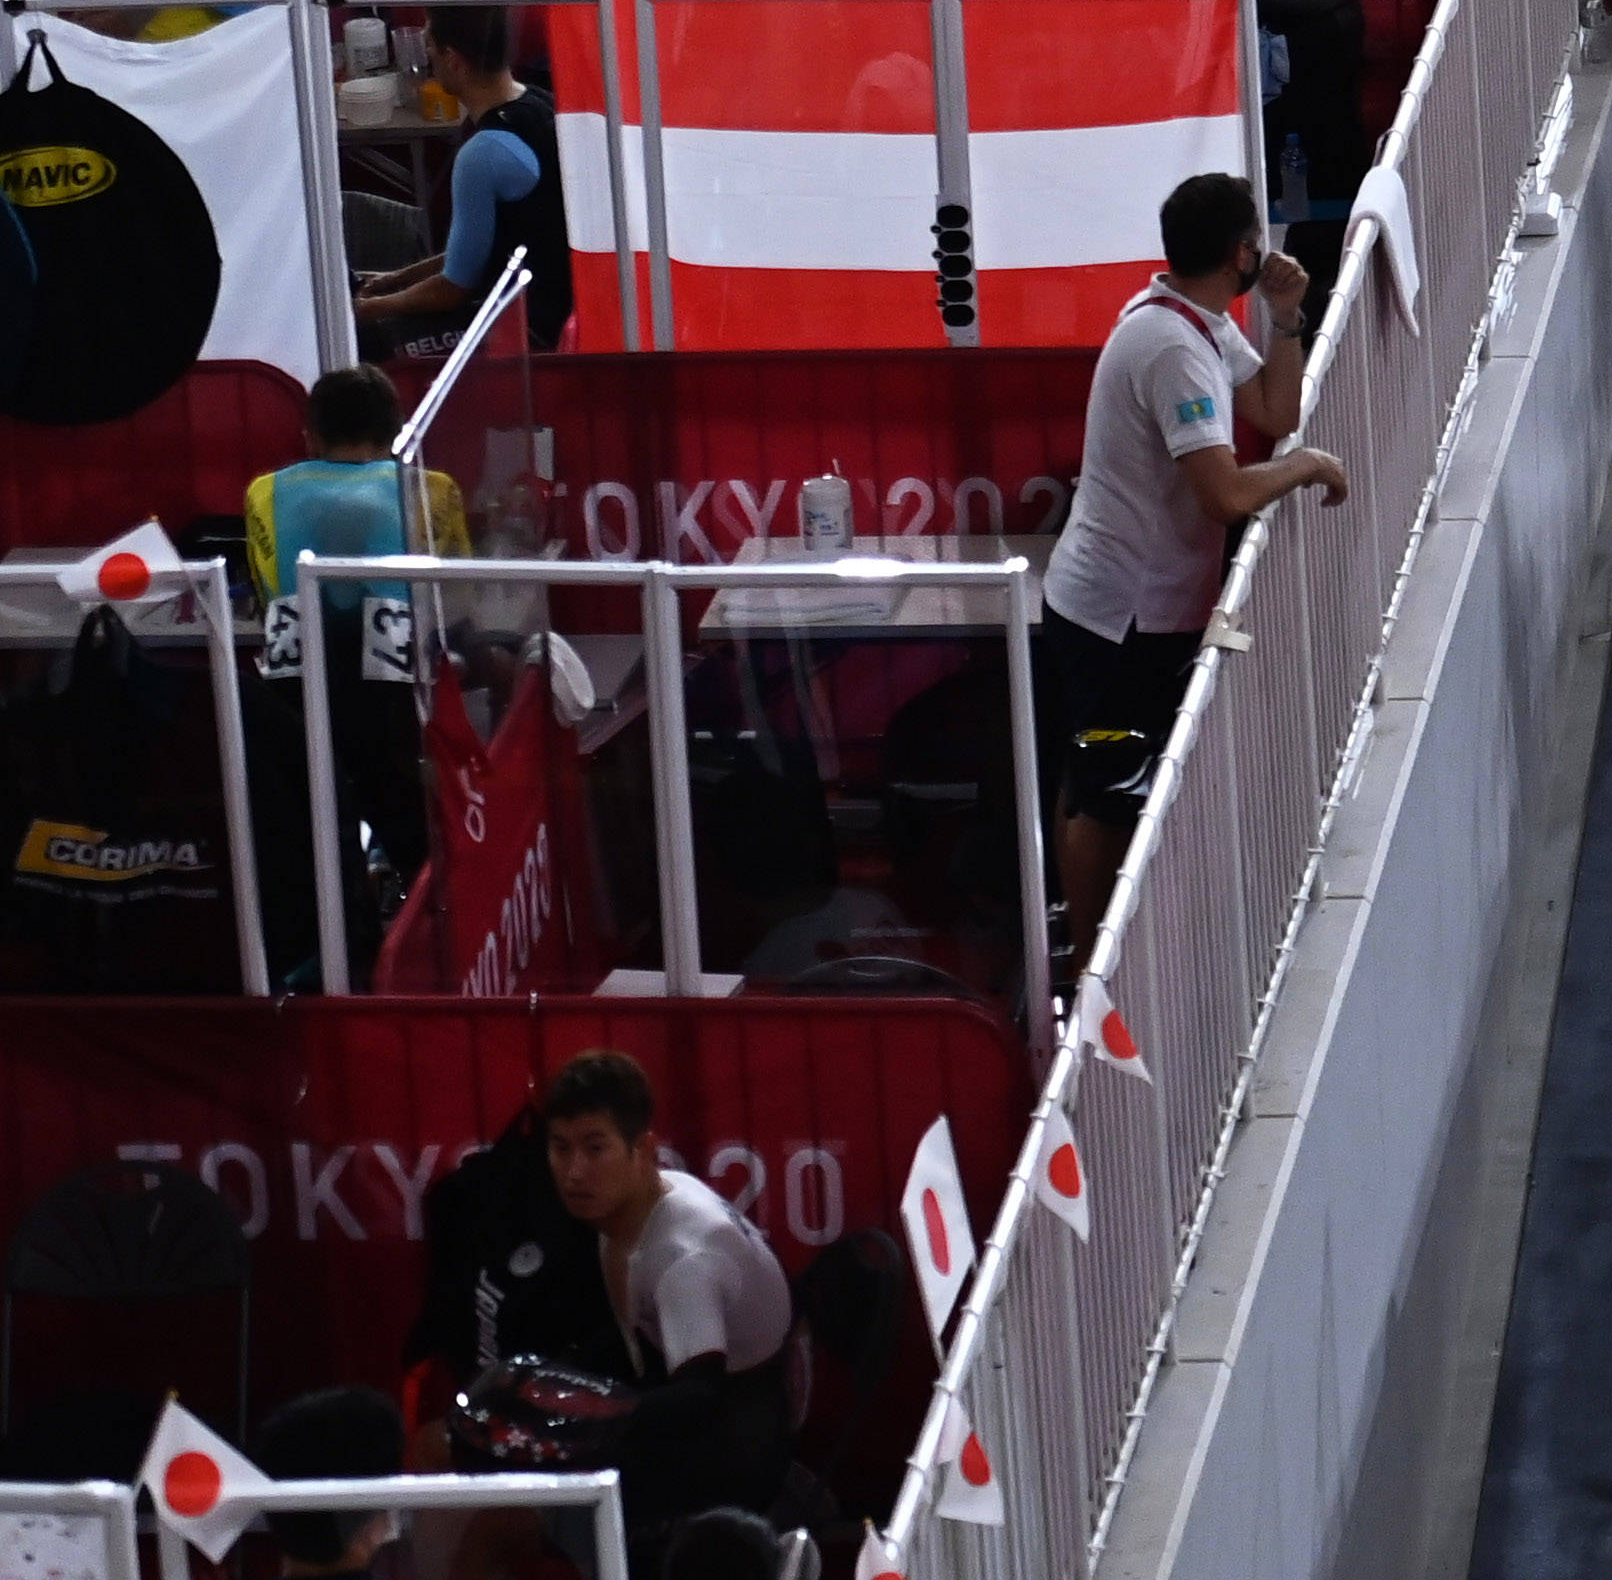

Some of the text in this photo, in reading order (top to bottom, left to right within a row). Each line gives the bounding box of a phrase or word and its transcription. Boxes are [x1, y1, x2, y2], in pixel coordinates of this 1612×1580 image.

[2, 163, 92, 191] MAVIC
[405, 331, 465, 359] BELG
[49, 837, 200, 872] CORIMA
